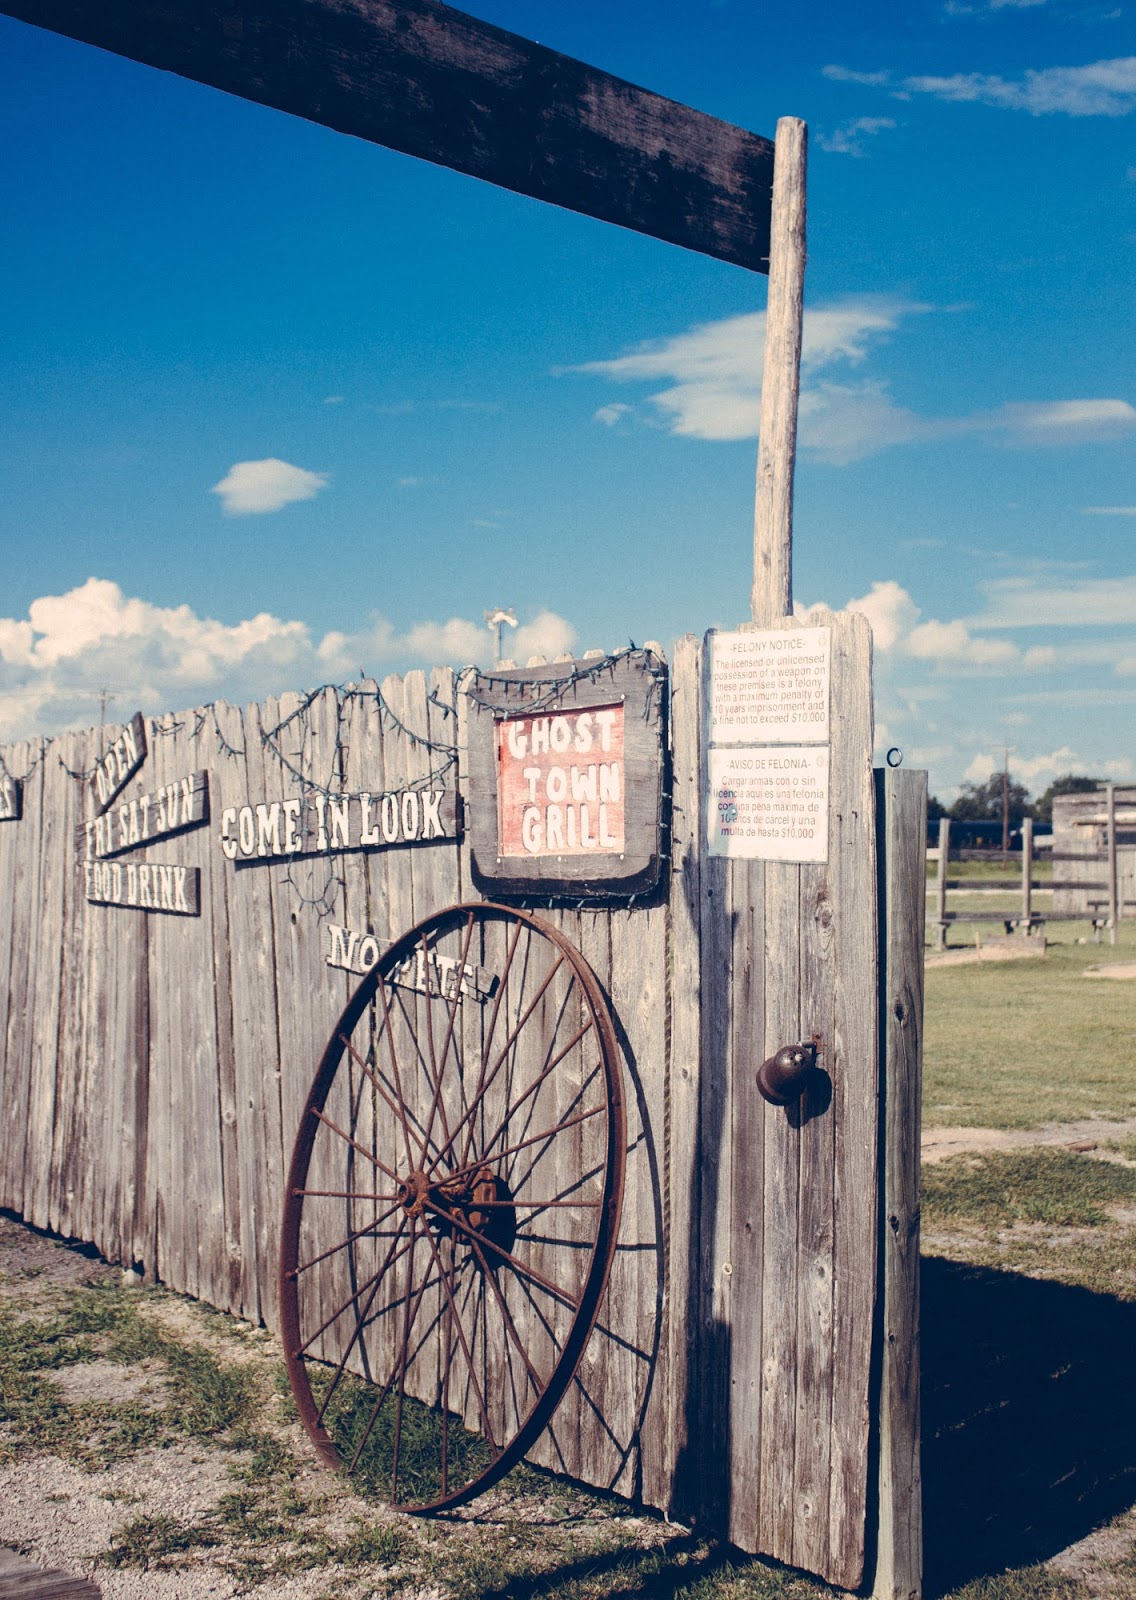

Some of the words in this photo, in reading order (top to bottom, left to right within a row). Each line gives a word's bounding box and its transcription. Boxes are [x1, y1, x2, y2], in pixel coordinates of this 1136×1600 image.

[716, 660, 728, 669] The
[732, 658, 763, 668] licensed
[766, 658, 774, 666] or
[778, 654, 824, 665] unlicensed
[714, 671, 757, 682] possession
[760, 668, 769, 677] of
[778, 668, 811, 678] weapon
[815, 667, 825, 675] on
[717, 682, 736, 691] these
[740, 680, 775, 692] premises
[778, 680, 786, 688] is
[795, 678, 822, 688] felony
[715, 693, 730, 702] with
[740, 692, 778, 701] maximum
[781, 690, 811, 704] penalty
[815, 690, 824, 698] of
[715, 705, 723, 714] 10
[726, 705, 745, 718] years
[748, 702, 805, 715] imprisonment
[808, 701, 824, 710] and
[720, 715, 733, 725] fine
[736, 715, 748, 724] not
[750, 716, 758, 724] to
[760, 713, 788, 724] exceed
[508, 711, 615, 759] GHOST
[96, 723, 138, 805] OPEN
[756, 760, 766, 769] DE
[523, 762, 620, 802] TOWN
[722, 776, 747, 787] Cargar
[749, 777, 773, 785] armas
[776, 777, 790, 785] con
[802, 776, 816, 785] sin
[714, 789, 744, 798] licencia
[765, 790, 774, 798] es
[777, 790, 791, 798] una
[752, 803, 770, 814] pena
[808, 803, 819, 812] de
[85, 811, 113, 860] FRI
[120, 794, 151, 847] SAT
[157, 774, 195, 832] SUN
[222, 799, 302, 859] COME
[315, 792, 350, 850] IN
[360, 790, 446, 844] LOOK
[754, 814, 763, 824] de
[798, 816, 816, 825] una
[522, 803, 617, 853] GRILL
[721, 828, 744, 836] multa
[746, 828, 756, 836] de
[758, 828, 778, 837] hasta
[83, 861, 122, 900] FOOD
[127, 863, 188, 912] DRINK
[326, 925, 380, 971] NO
